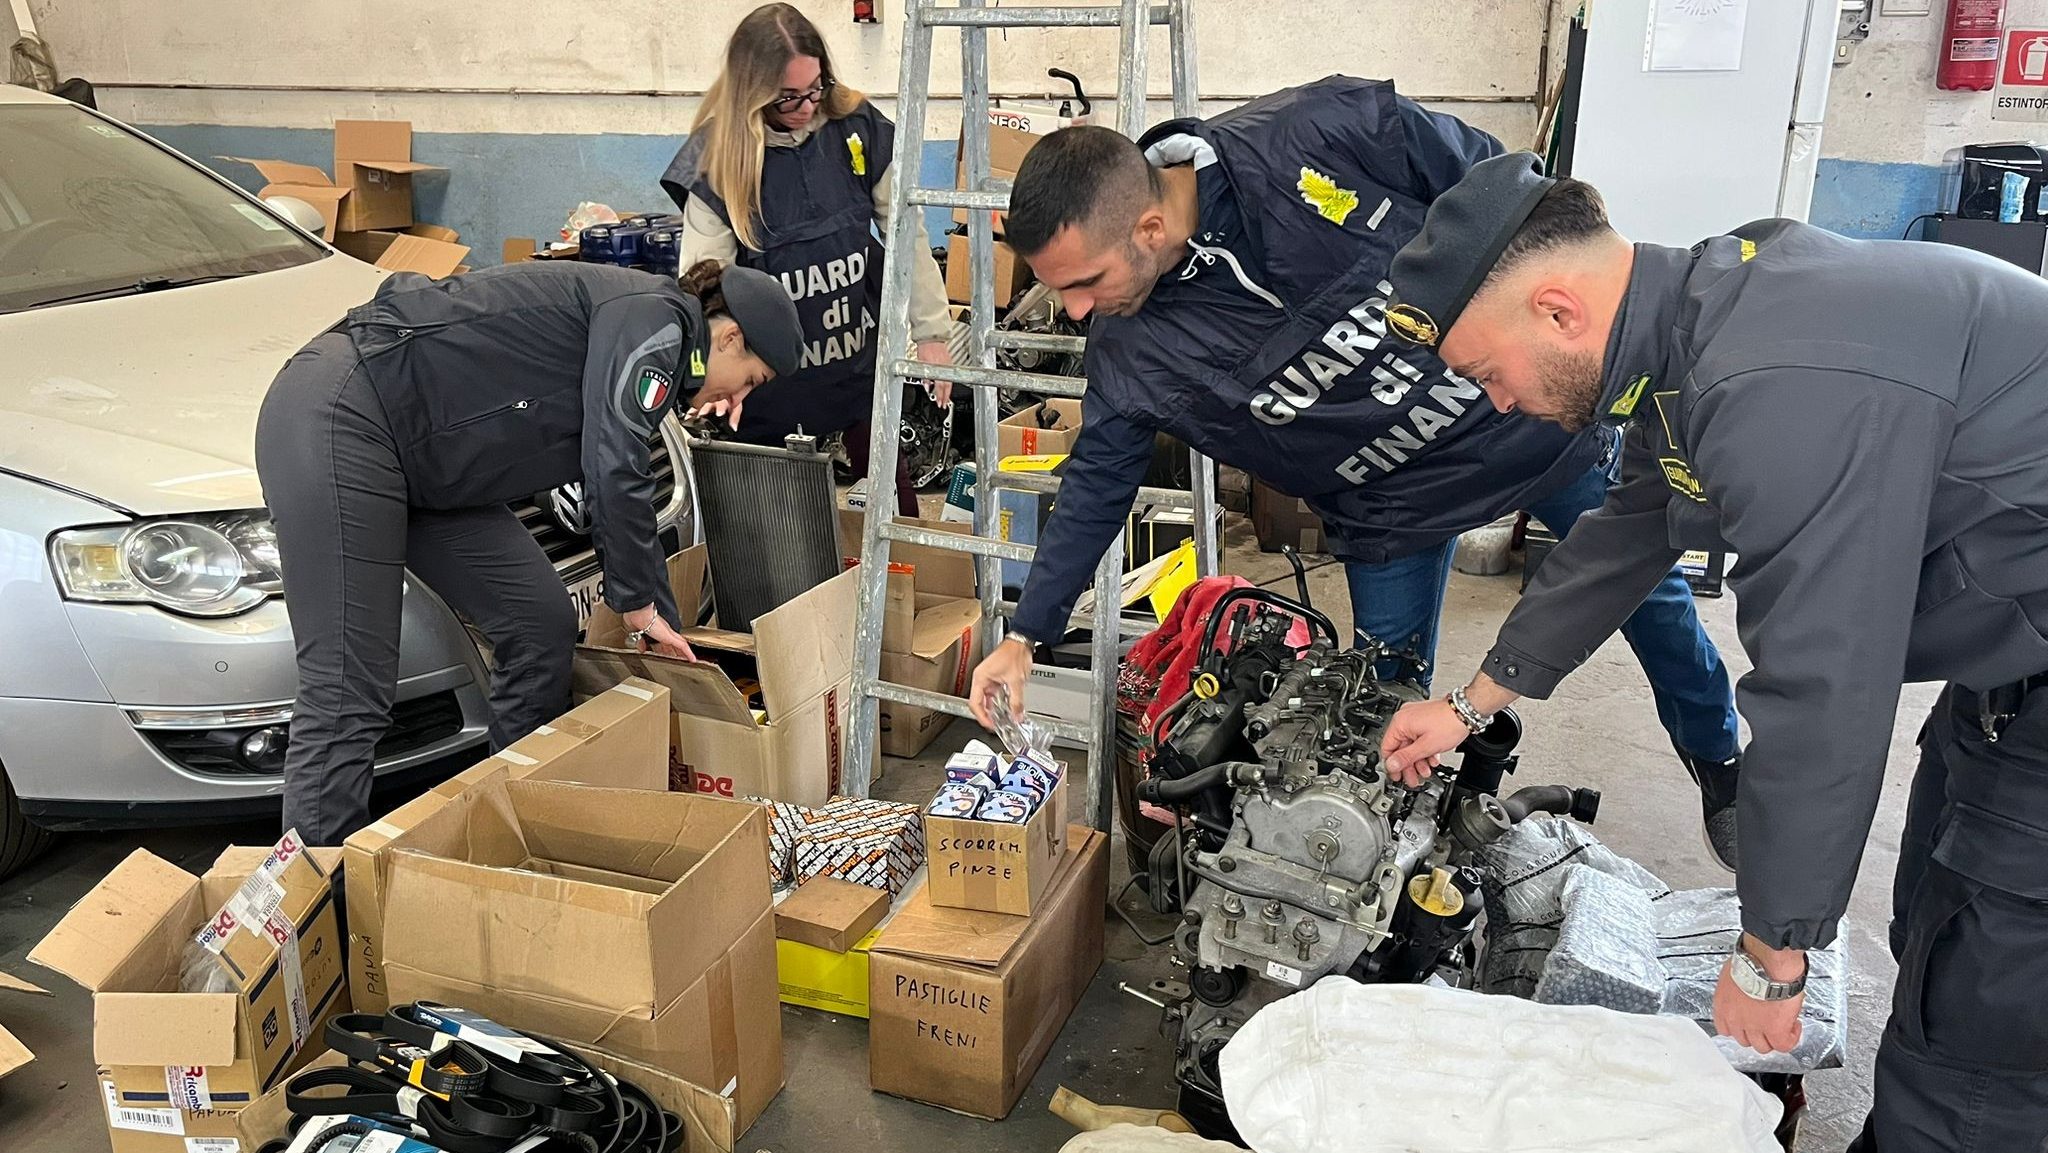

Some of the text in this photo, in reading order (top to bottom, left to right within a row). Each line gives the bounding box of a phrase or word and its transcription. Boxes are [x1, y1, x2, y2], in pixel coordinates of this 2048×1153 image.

[769, 246, 869, 301] UARD
[822, 296, 850, 330] di
[1250, 279, 1394, 426] GUARD
[645, 371, 669, 387] ITALIA
[1370, 352, 1424, 406] di
[949, 861, 1012, 879] PINZE
[361, 935, 386, 996] PANDA
[896, 974, 992, 1014] PASTIGLIE
[917, 1018, 976, 1048] FRENI
